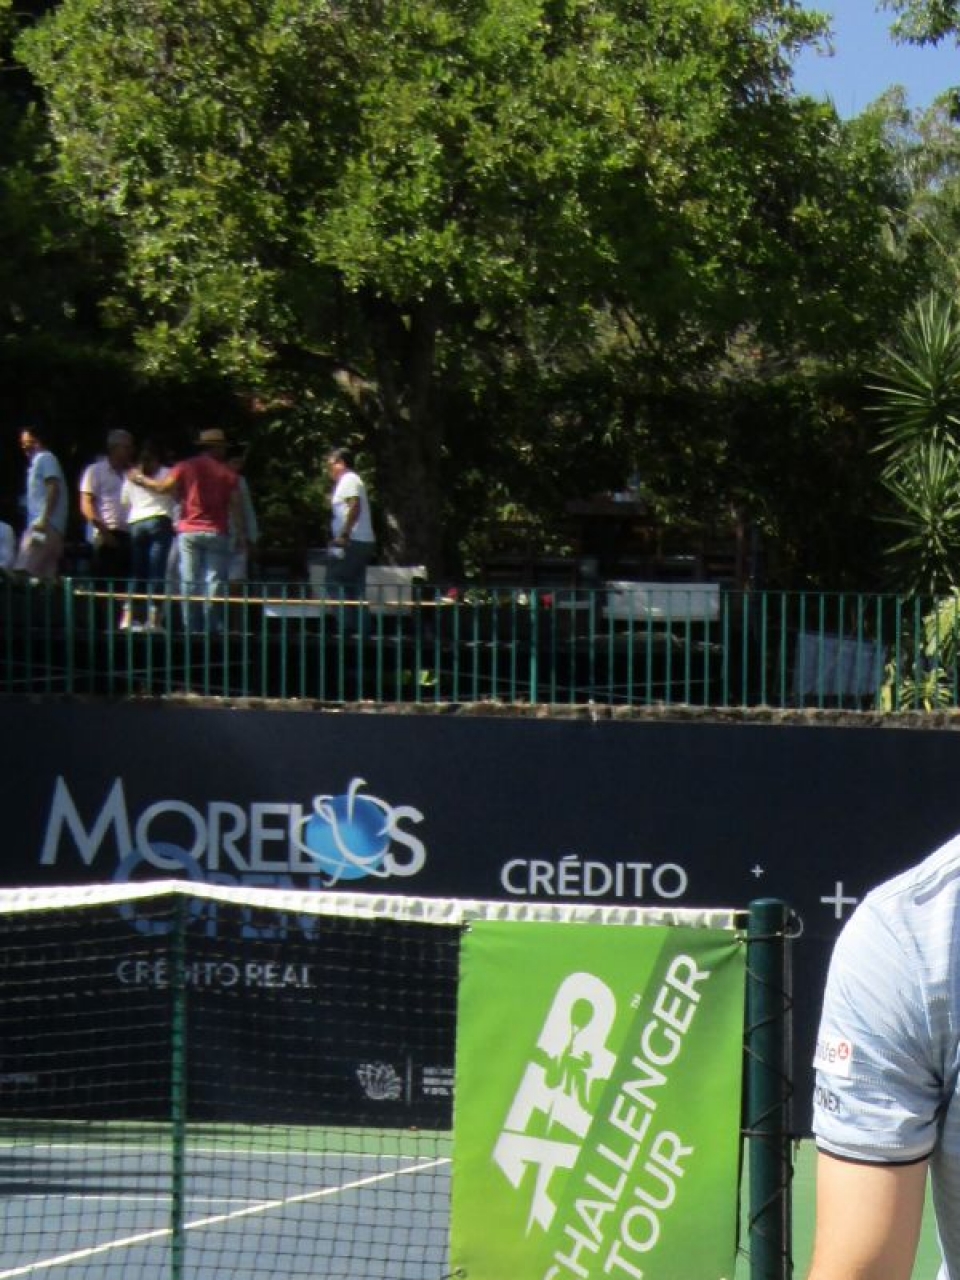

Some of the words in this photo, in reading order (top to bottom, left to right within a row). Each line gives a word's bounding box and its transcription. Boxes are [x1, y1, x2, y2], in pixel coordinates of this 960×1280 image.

[500, 855, 688, 898] CRÉDITO
[116, 957, 239, 987] CRÉITO
[492, 972, 616, 1238] ATP
[604, 1130, 694, 1280] TOUR
